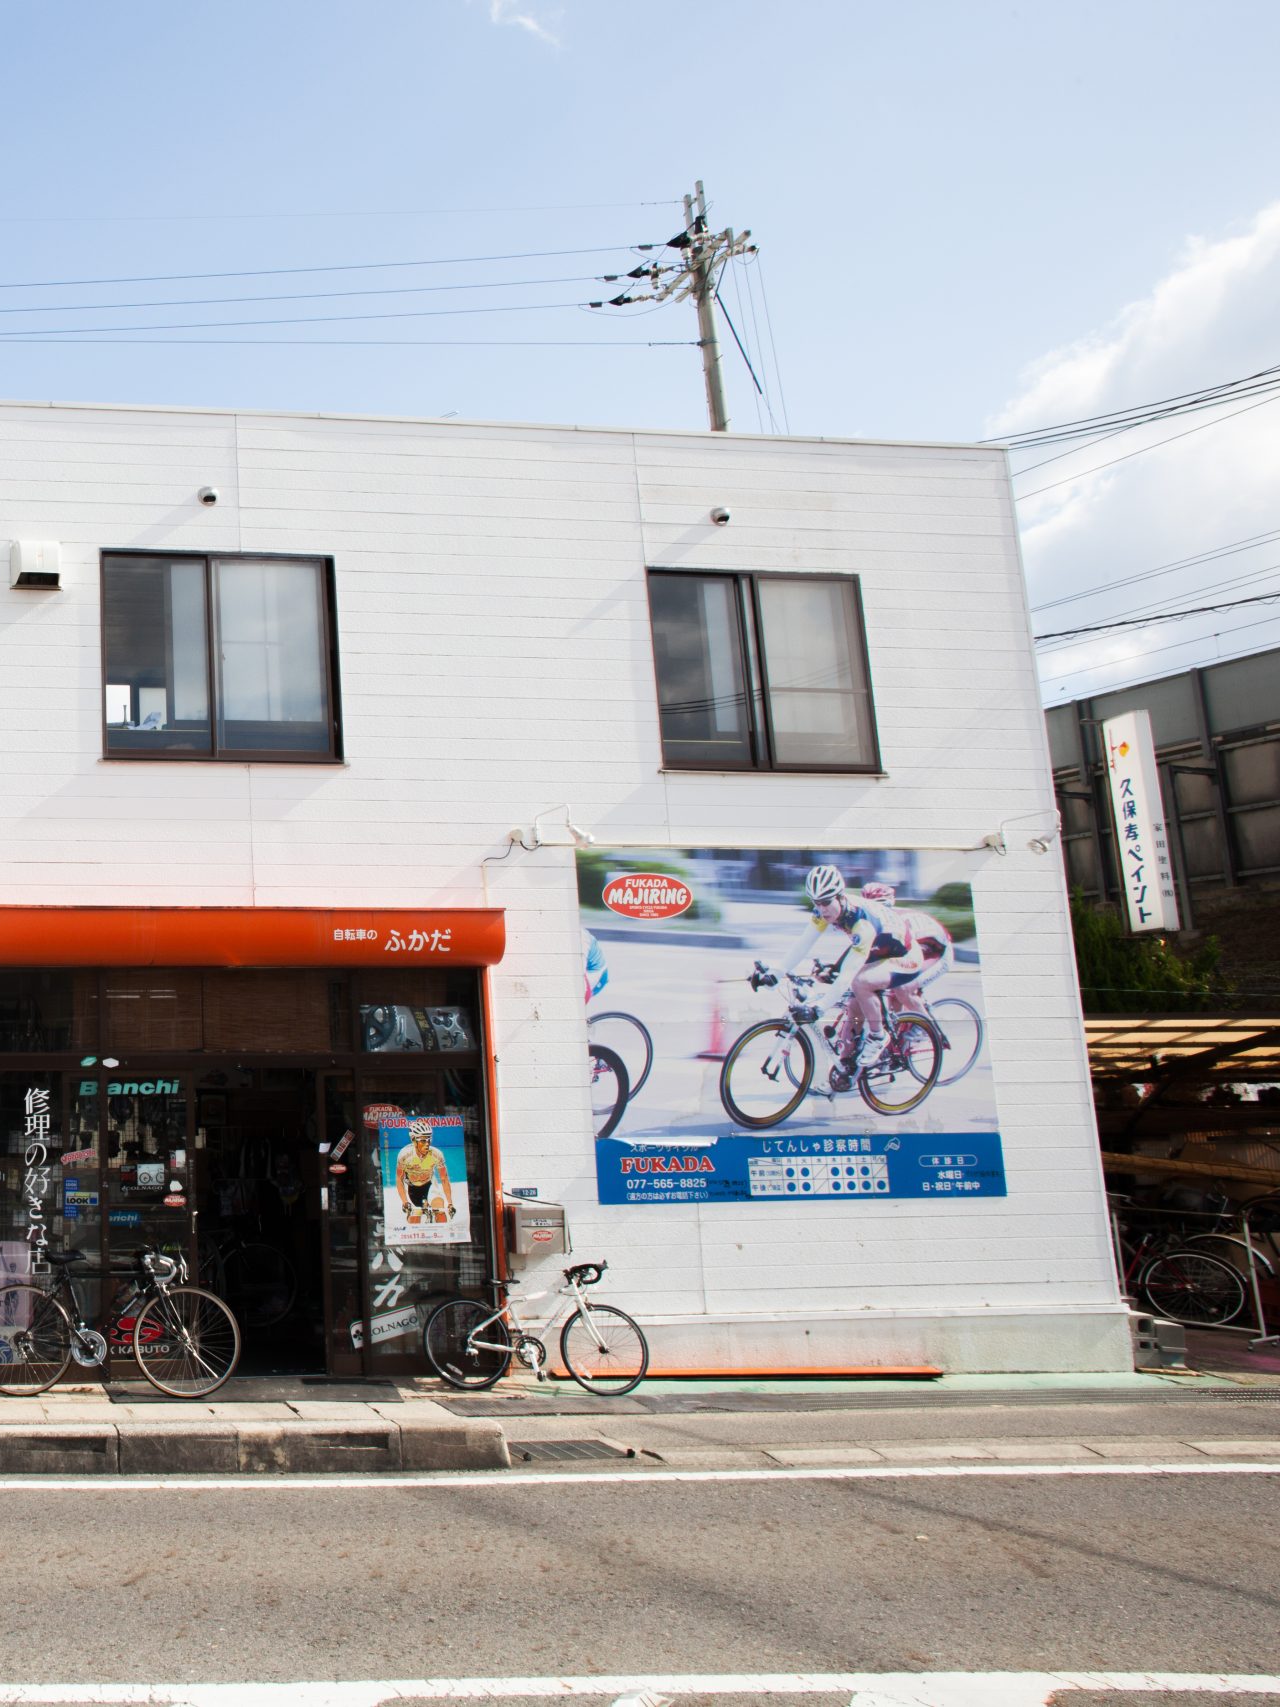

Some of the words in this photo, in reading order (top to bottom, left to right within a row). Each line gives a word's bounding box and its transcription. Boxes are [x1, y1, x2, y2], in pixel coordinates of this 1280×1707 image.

[625, 879, 668, 888] FUKADA
[607, 888, 688, 905] MAJIRING
[333, 929, 378, 941] 自転車の
[384, 928, 452, 952] ふかだ
[79, 1080, 180, 1096] Banchi
[381, 1117, 407, 1128] TOUR
[416, 1116, 463, 1127] OKINAWA
[763, 1138, 871, 1153] じてんしゃ診察時間
[620, 1156, 716, 1174] FUKADA
[24, 1087, 52, 1275] 修理の好きな店
[626, 1178, 707, 1189] 077-565-8825
[370, 1315, 418, 1336] OLNAGO
[118, 1345, 170, 1354] KABUTO
